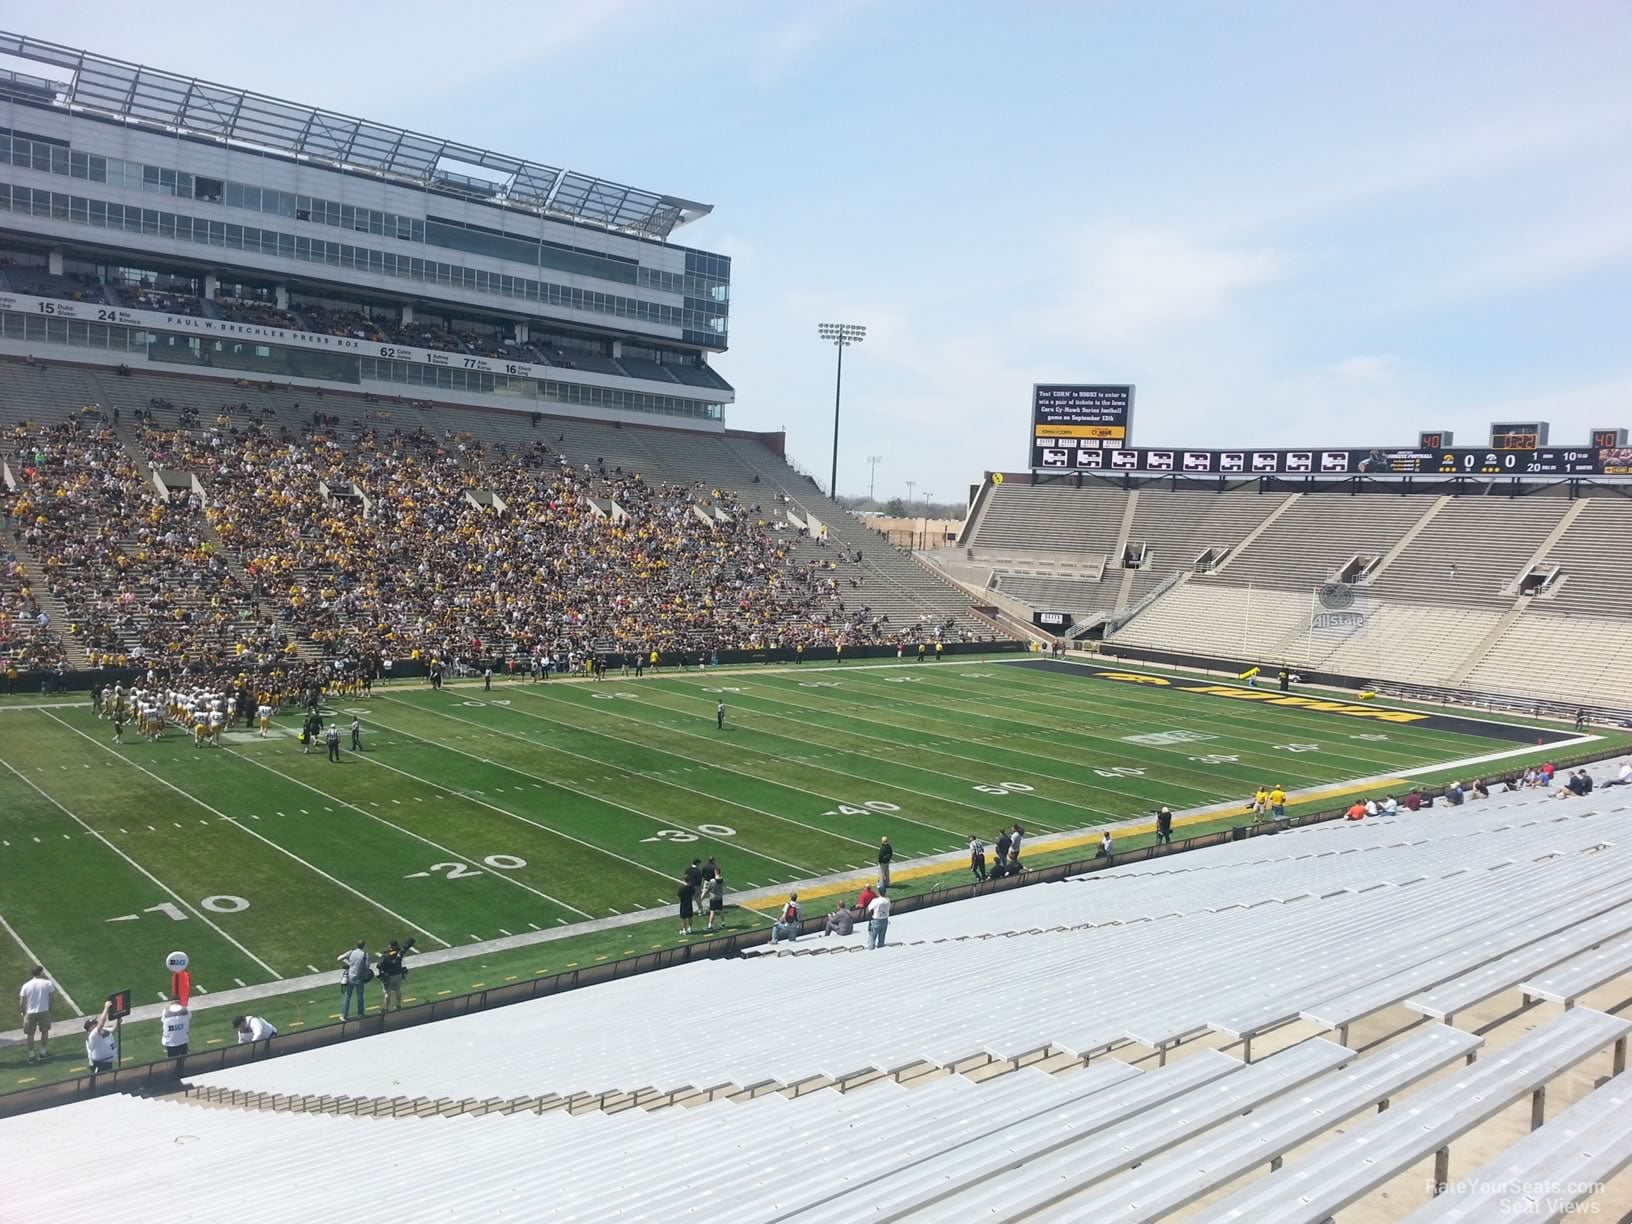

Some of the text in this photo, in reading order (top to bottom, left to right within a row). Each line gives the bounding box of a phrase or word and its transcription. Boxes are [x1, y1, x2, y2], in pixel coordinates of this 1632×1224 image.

[38, 302, 54, 314] 15
[98, 310, 116, 321] 24
[168, 317, 199, 327] PAUL
[221, 324, 285, 338] BRECHLER
[292, 334, 329, 344] PRESS
[338, 340, 359, 348] BOX
[380, 347, 394, 358] 62
[426, 354, 431, 362] 1
[464, 358, 476, 368] 77
[506, 364, 517, 374] 16
[1423, 436, 1440, 448] 40
[1504, 434, 1534, 448] 0:22
[1596, 434, 1614, 446] 40
[1464, 455, 1474, 467] 0
[1505, 454, 1516, 468] 0
[1532, 452, 1537, 460] 1
[1563, 452, 1576, 460] 10
[1527, 463, 1540, 472] 20
[1565, 464, 1570, 472] 1
[1312, 613, 1364, 628] Allstate
[1174, 686, 1430, 723] IOWA
[972, 781, 1035, 796] 50
[836, 800, 901, 816] 40
[656, 823, 738, 844] 30
[429, 854, 528, 880] 20
[144, 894, 251, 922] 10
